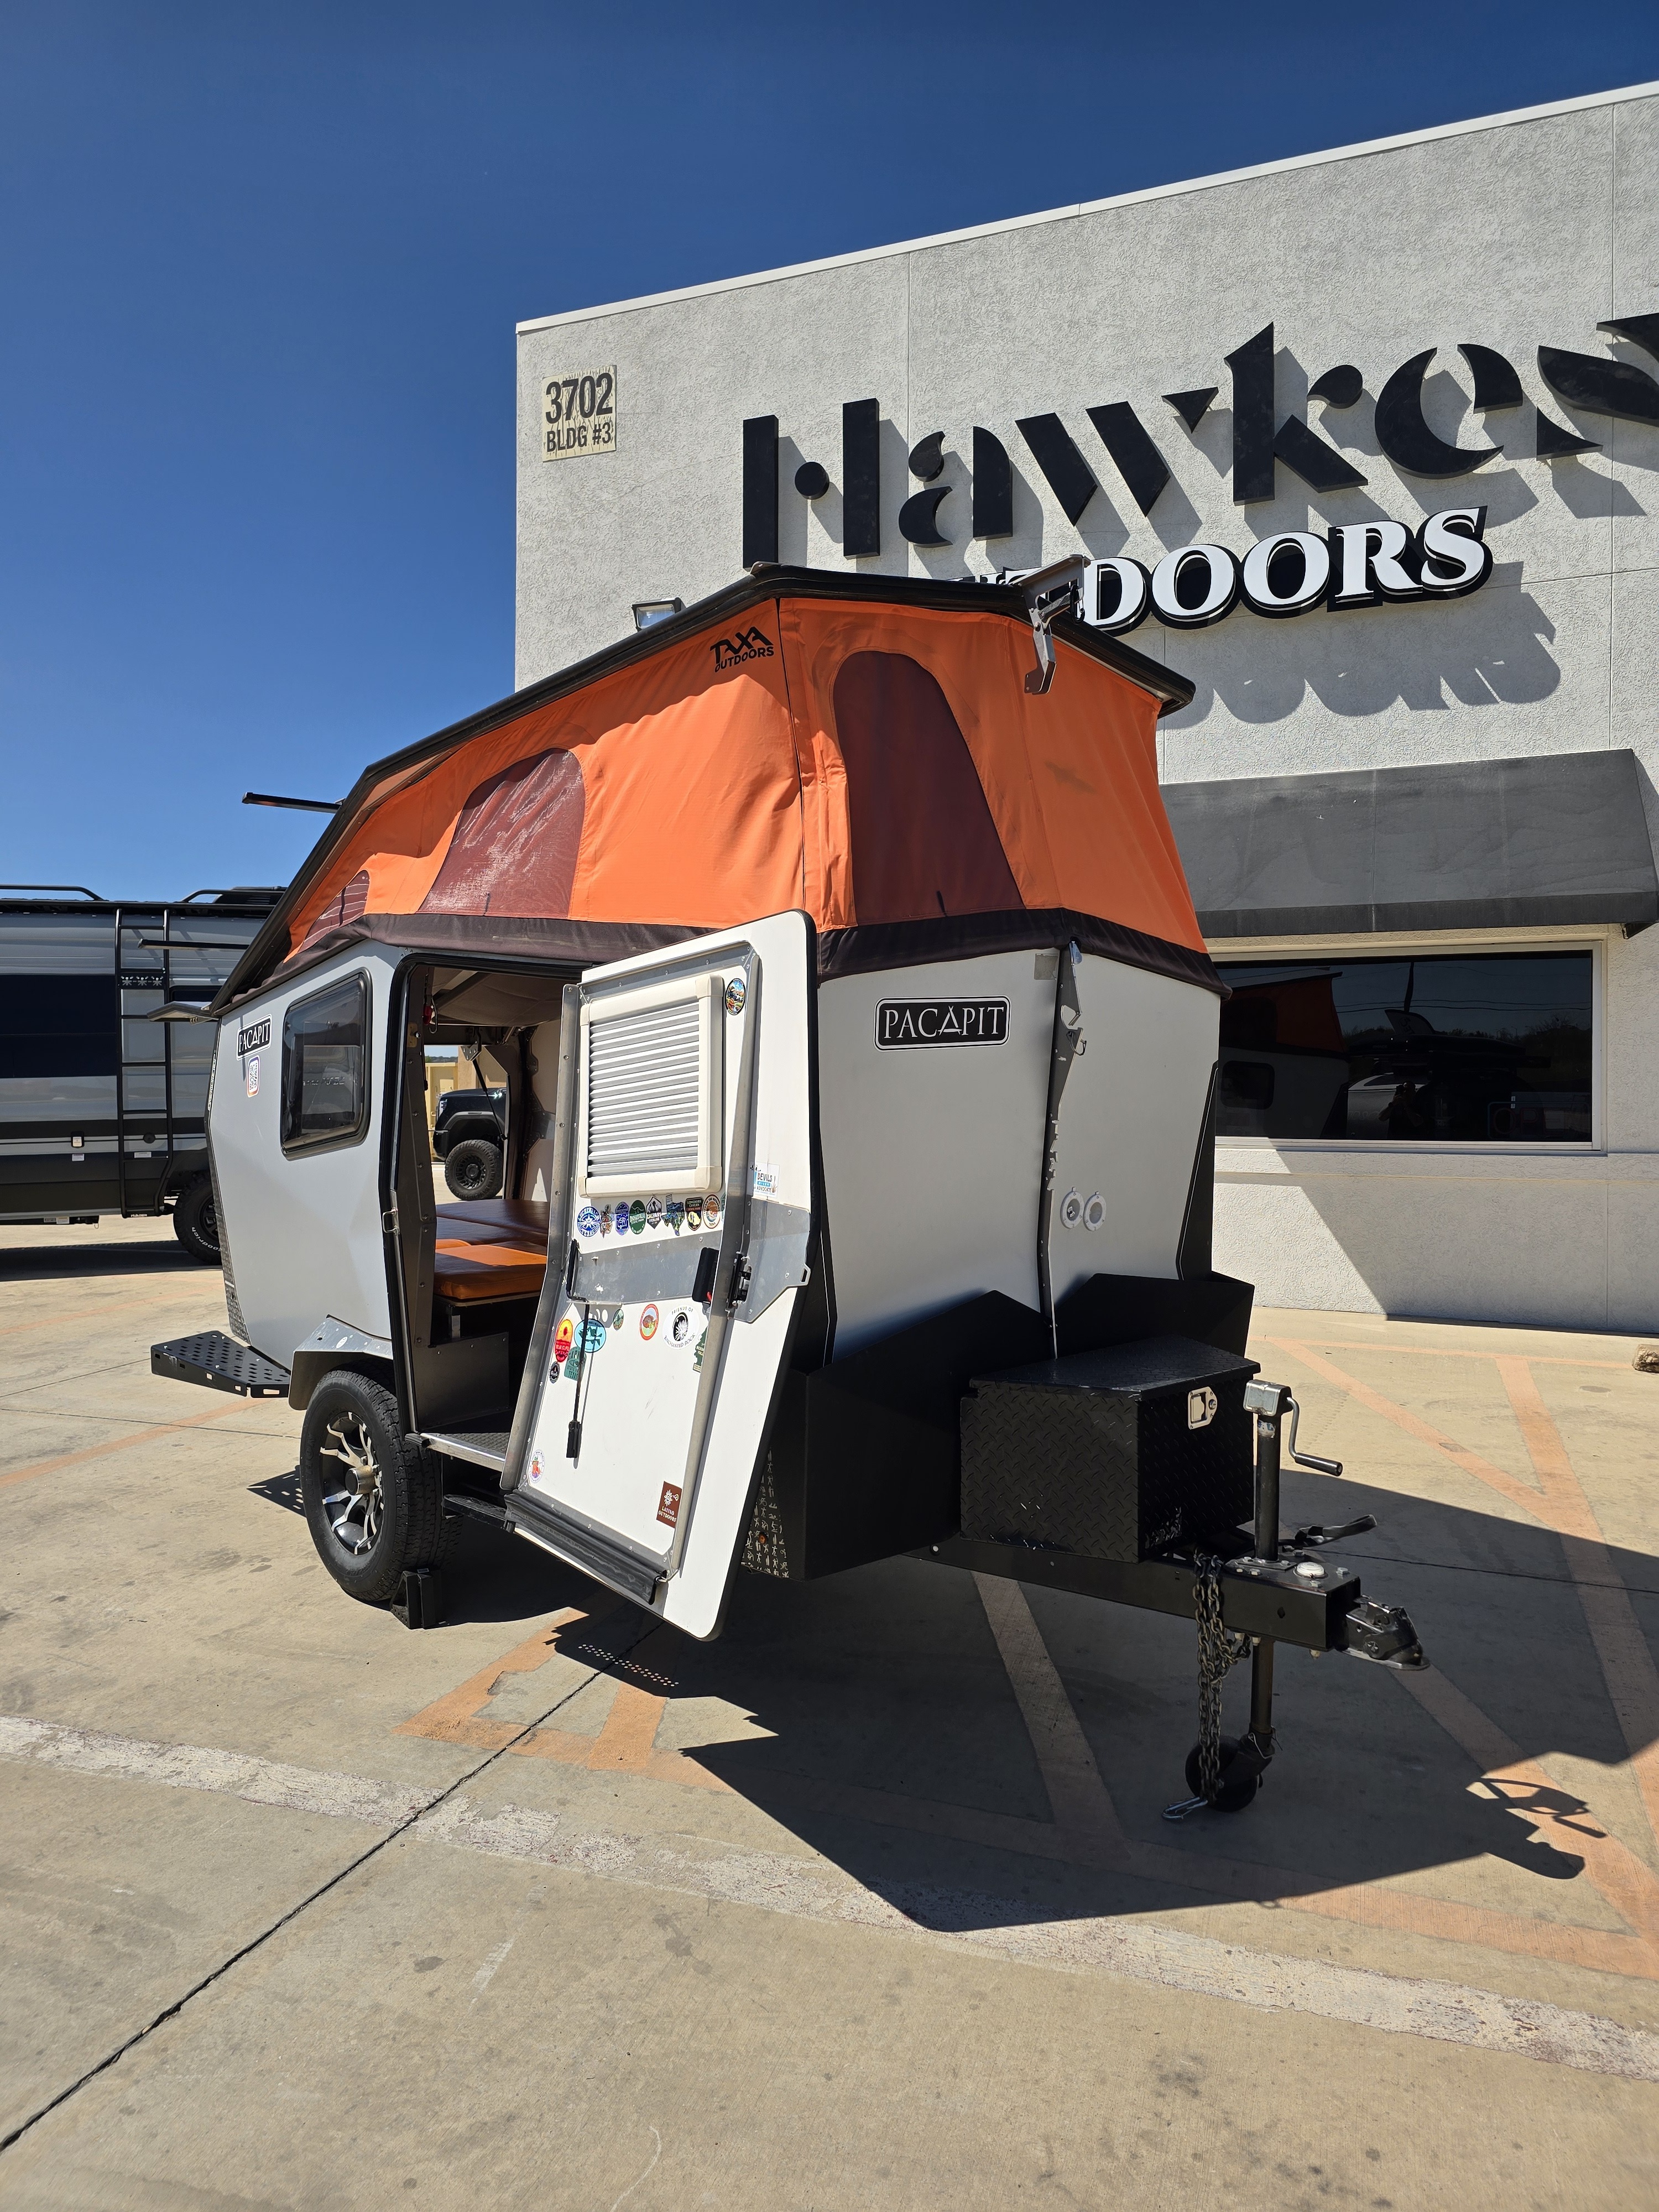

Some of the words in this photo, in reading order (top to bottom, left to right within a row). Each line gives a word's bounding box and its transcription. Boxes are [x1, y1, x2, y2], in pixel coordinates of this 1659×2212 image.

[545, 372, 613, 424] 3702
[547, 425, 587, 452] BLDG
[592, 422, 611, 445] #3
[710, 627, 774, 664] TAXA
[715, 646, 774, 672] OUTDOORS
[884, 1005, 1004, 1039] PACAPIT
[238, 1021, 270, 1053] PACAPIT
[757, 1172, 773, 1182] DEVILS
[664, 1335, 684, 1348] ENCHANTED
[684, 1333, 696, 1346] ROCK
[658, 1510, 677, 1522] OUTDOORS
[661, 1506, 675, 1515] LATINO
